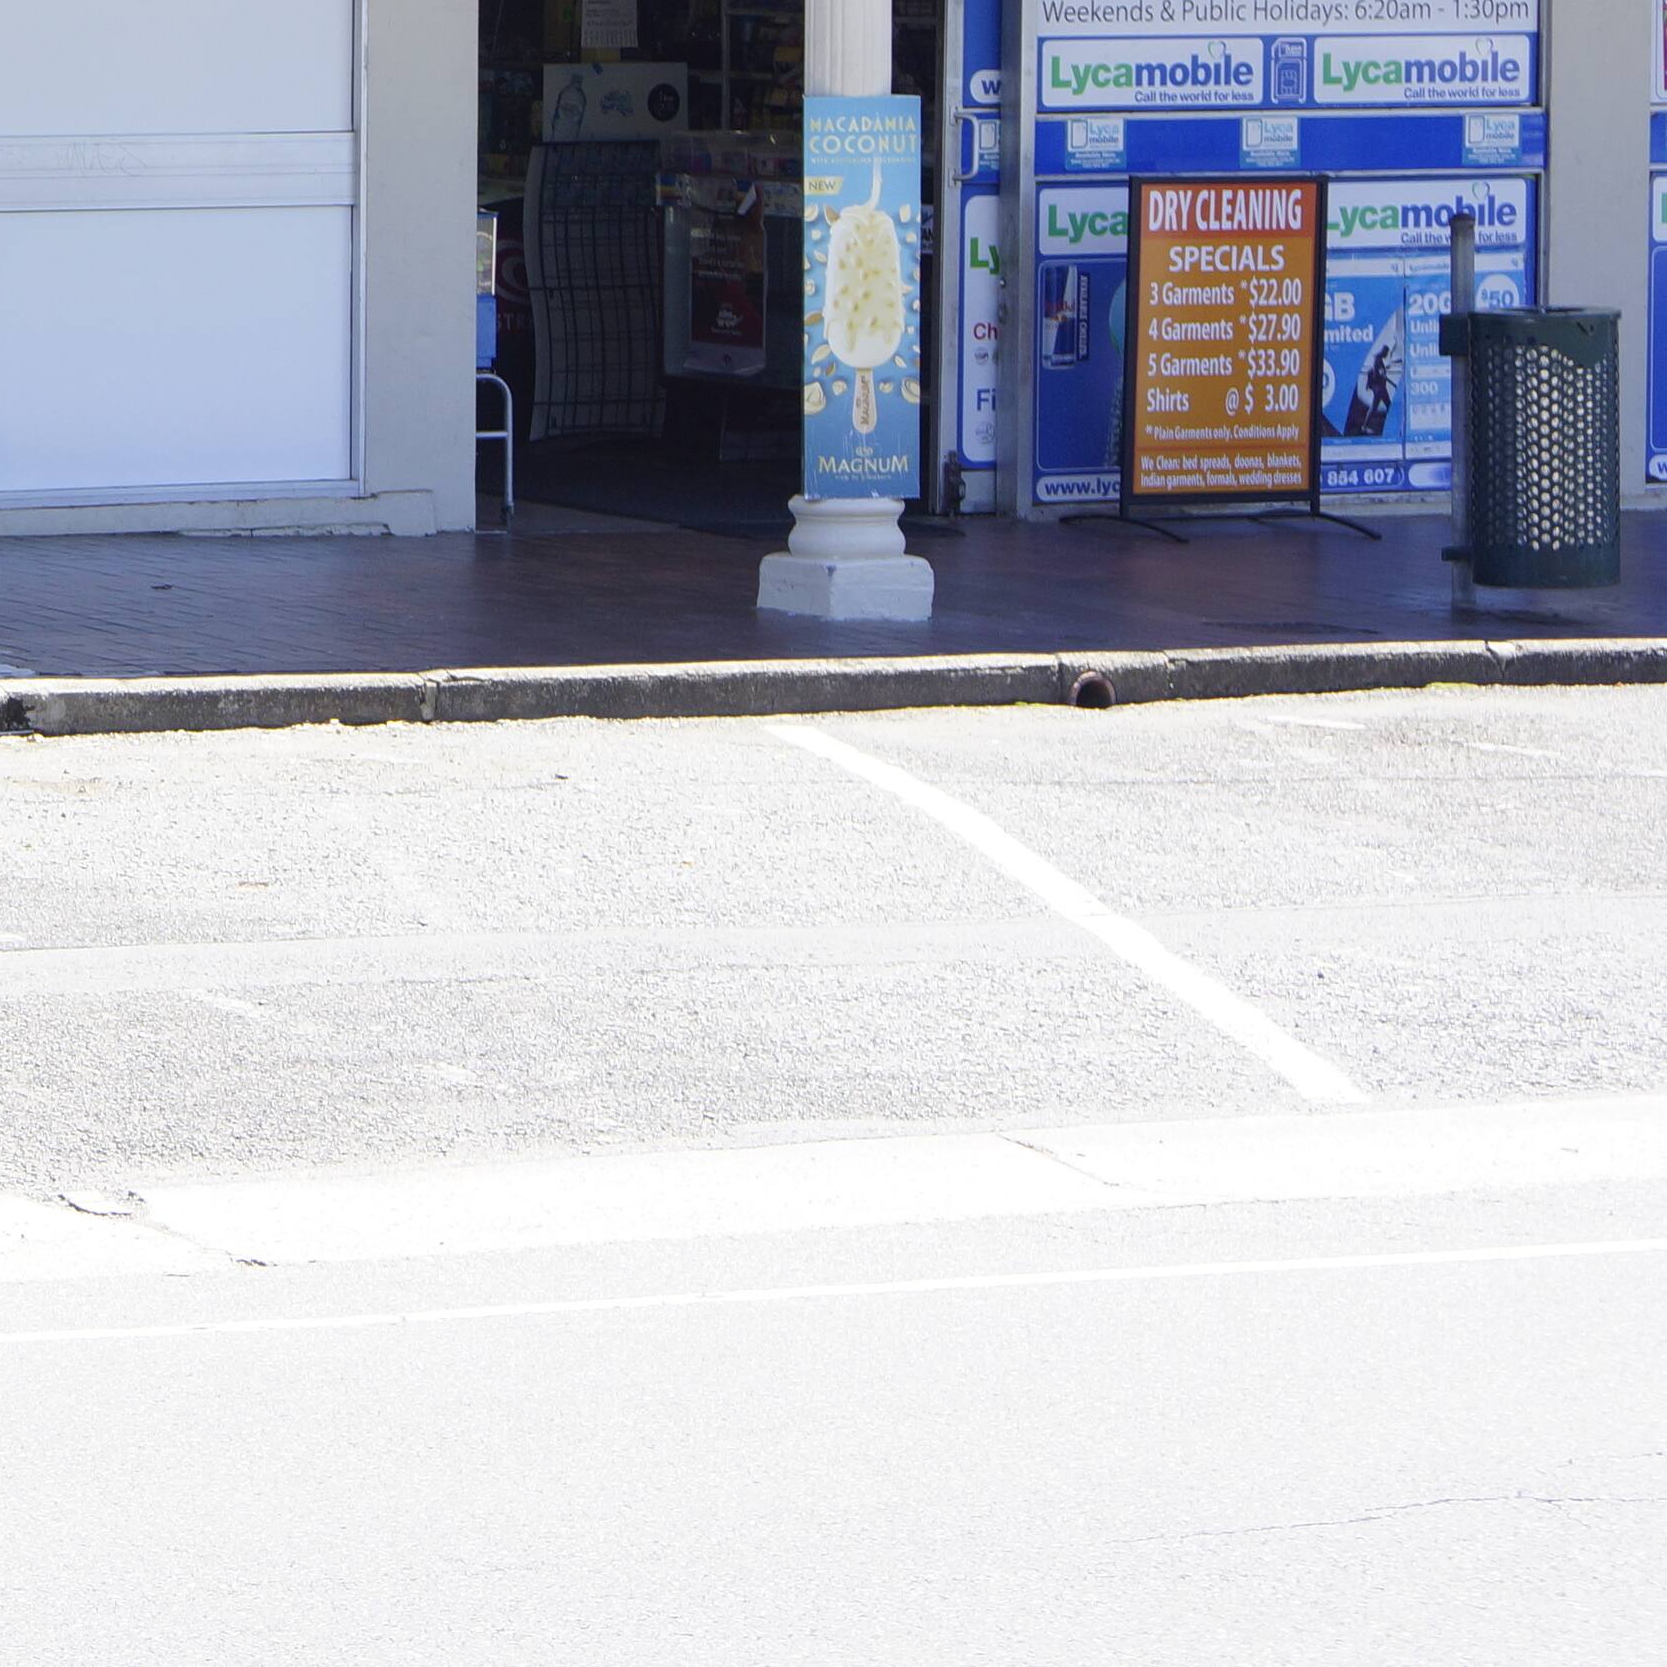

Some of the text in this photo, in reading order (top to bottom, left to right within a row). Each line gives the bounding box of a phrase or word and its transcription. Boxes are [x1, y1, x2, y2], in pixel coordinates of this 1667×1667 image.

[1051, 53, 1254, 96] Lycamobile
[1322, 50, 1520, 92] Lycamobile
[1134, 90, 1254, 103] Call the world for less
[1404, 86, 1520, 99] Call the world for less
[809, 135, 917, 155] COCONUT
[808, 180, 836, 192] NEW
[1149, 188, 1303, 232] DRY CLEANING
[1401, 231, 1424, 244] Call
[1425, 231, 1443, 243] the
[1478, 230, 1494, 242] for
[1495, 230, 1517, 241] less
[1169, 245, 1285, 272] SPECIALS
[1150, 282, 1159, 305] 3
[1163, 281, 1235, 305] Garments
[1149, 318, 1158, 341] 4
[1162, 317, 1233, 341] Garments
[1147, 353, 1157, 377] 5
[1161, 352, 1233, 376] Garments
[1147, 387, 1189, 412] Shirts
[1225, 387, 1240, 416] @
[1265, 384, 1299, 412] 3.00
[1175, 425, 1212, 440] Garments
[1233, 424, 1276, 439] Conditions
[1276, 423, 1300, 441] Apply
[818, 454, 909, 474] MAGNUM
[1141, 455, 1154, 469] We
[1182, 454, 1198, 469] bed
[1200, 454, 1231, 472] spreads,
[1234, 453, 1264, 470] doonas,
[1267, 452, 1302, 469] blankets,
[1140, 472, 1165, 487] Indian
[1238, 471, 1272, 488] wedding
[1273, 470, 1302, 484] dresses
[1327, 467, 1395, 486] 854 607
